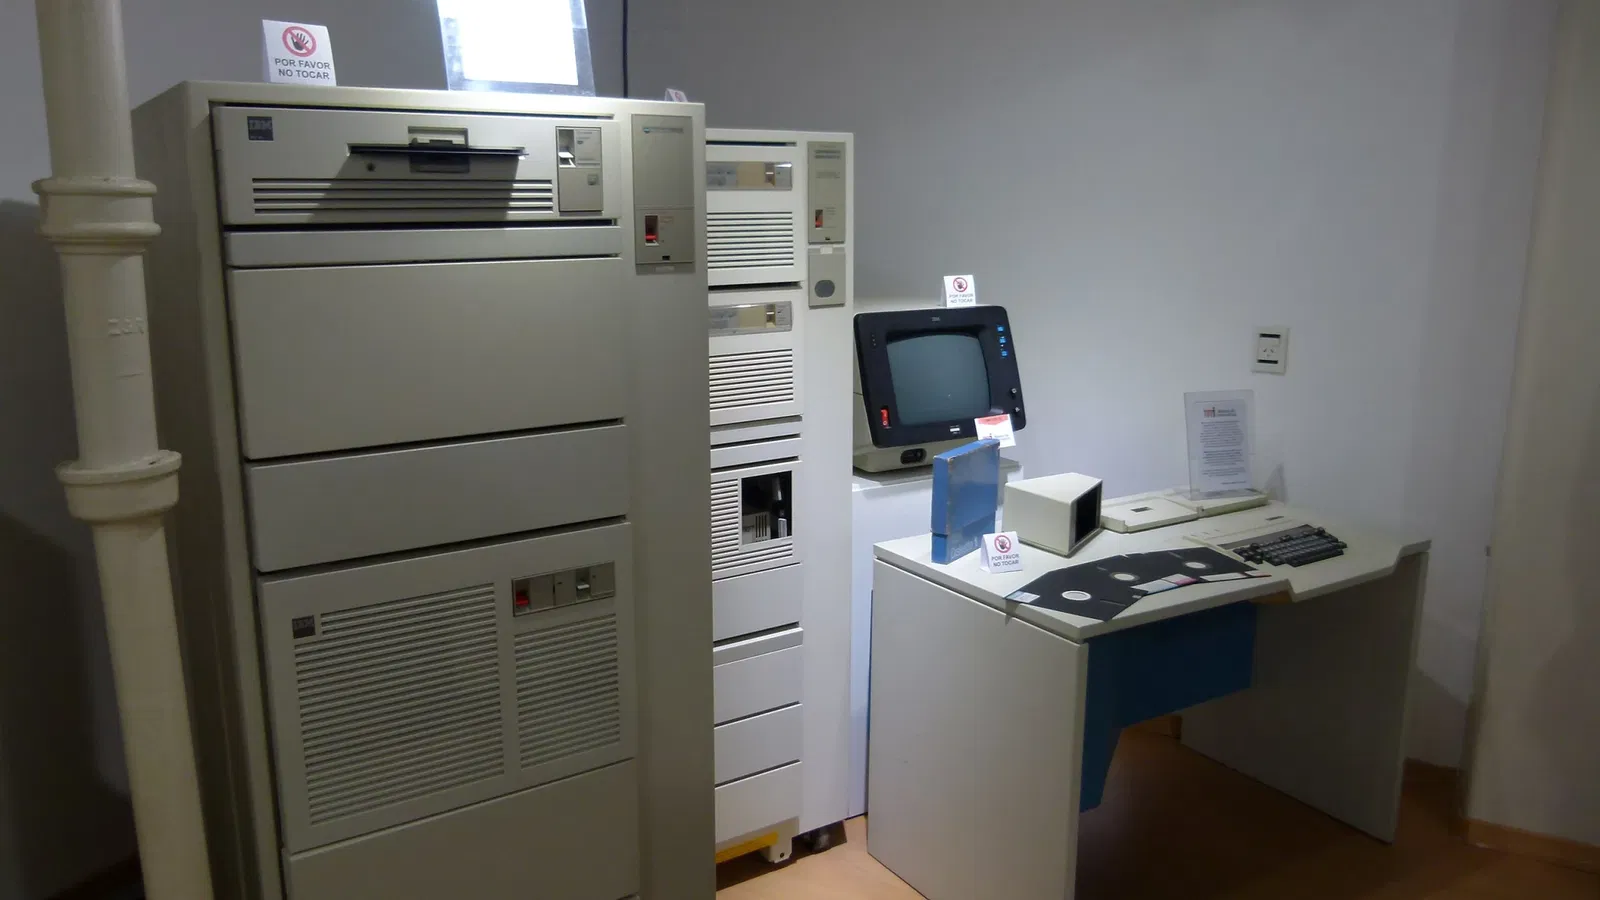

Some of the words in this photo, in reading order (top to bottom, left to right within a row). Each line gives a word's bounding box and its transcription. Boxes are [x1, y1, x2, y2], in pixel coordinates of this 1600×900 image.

[275, 58, 296, 67] POR
[298, 60, 330, 70] FAVOR
[278, 69, 293, 77] NO
[295, 70, 330, 80] TOCAR
